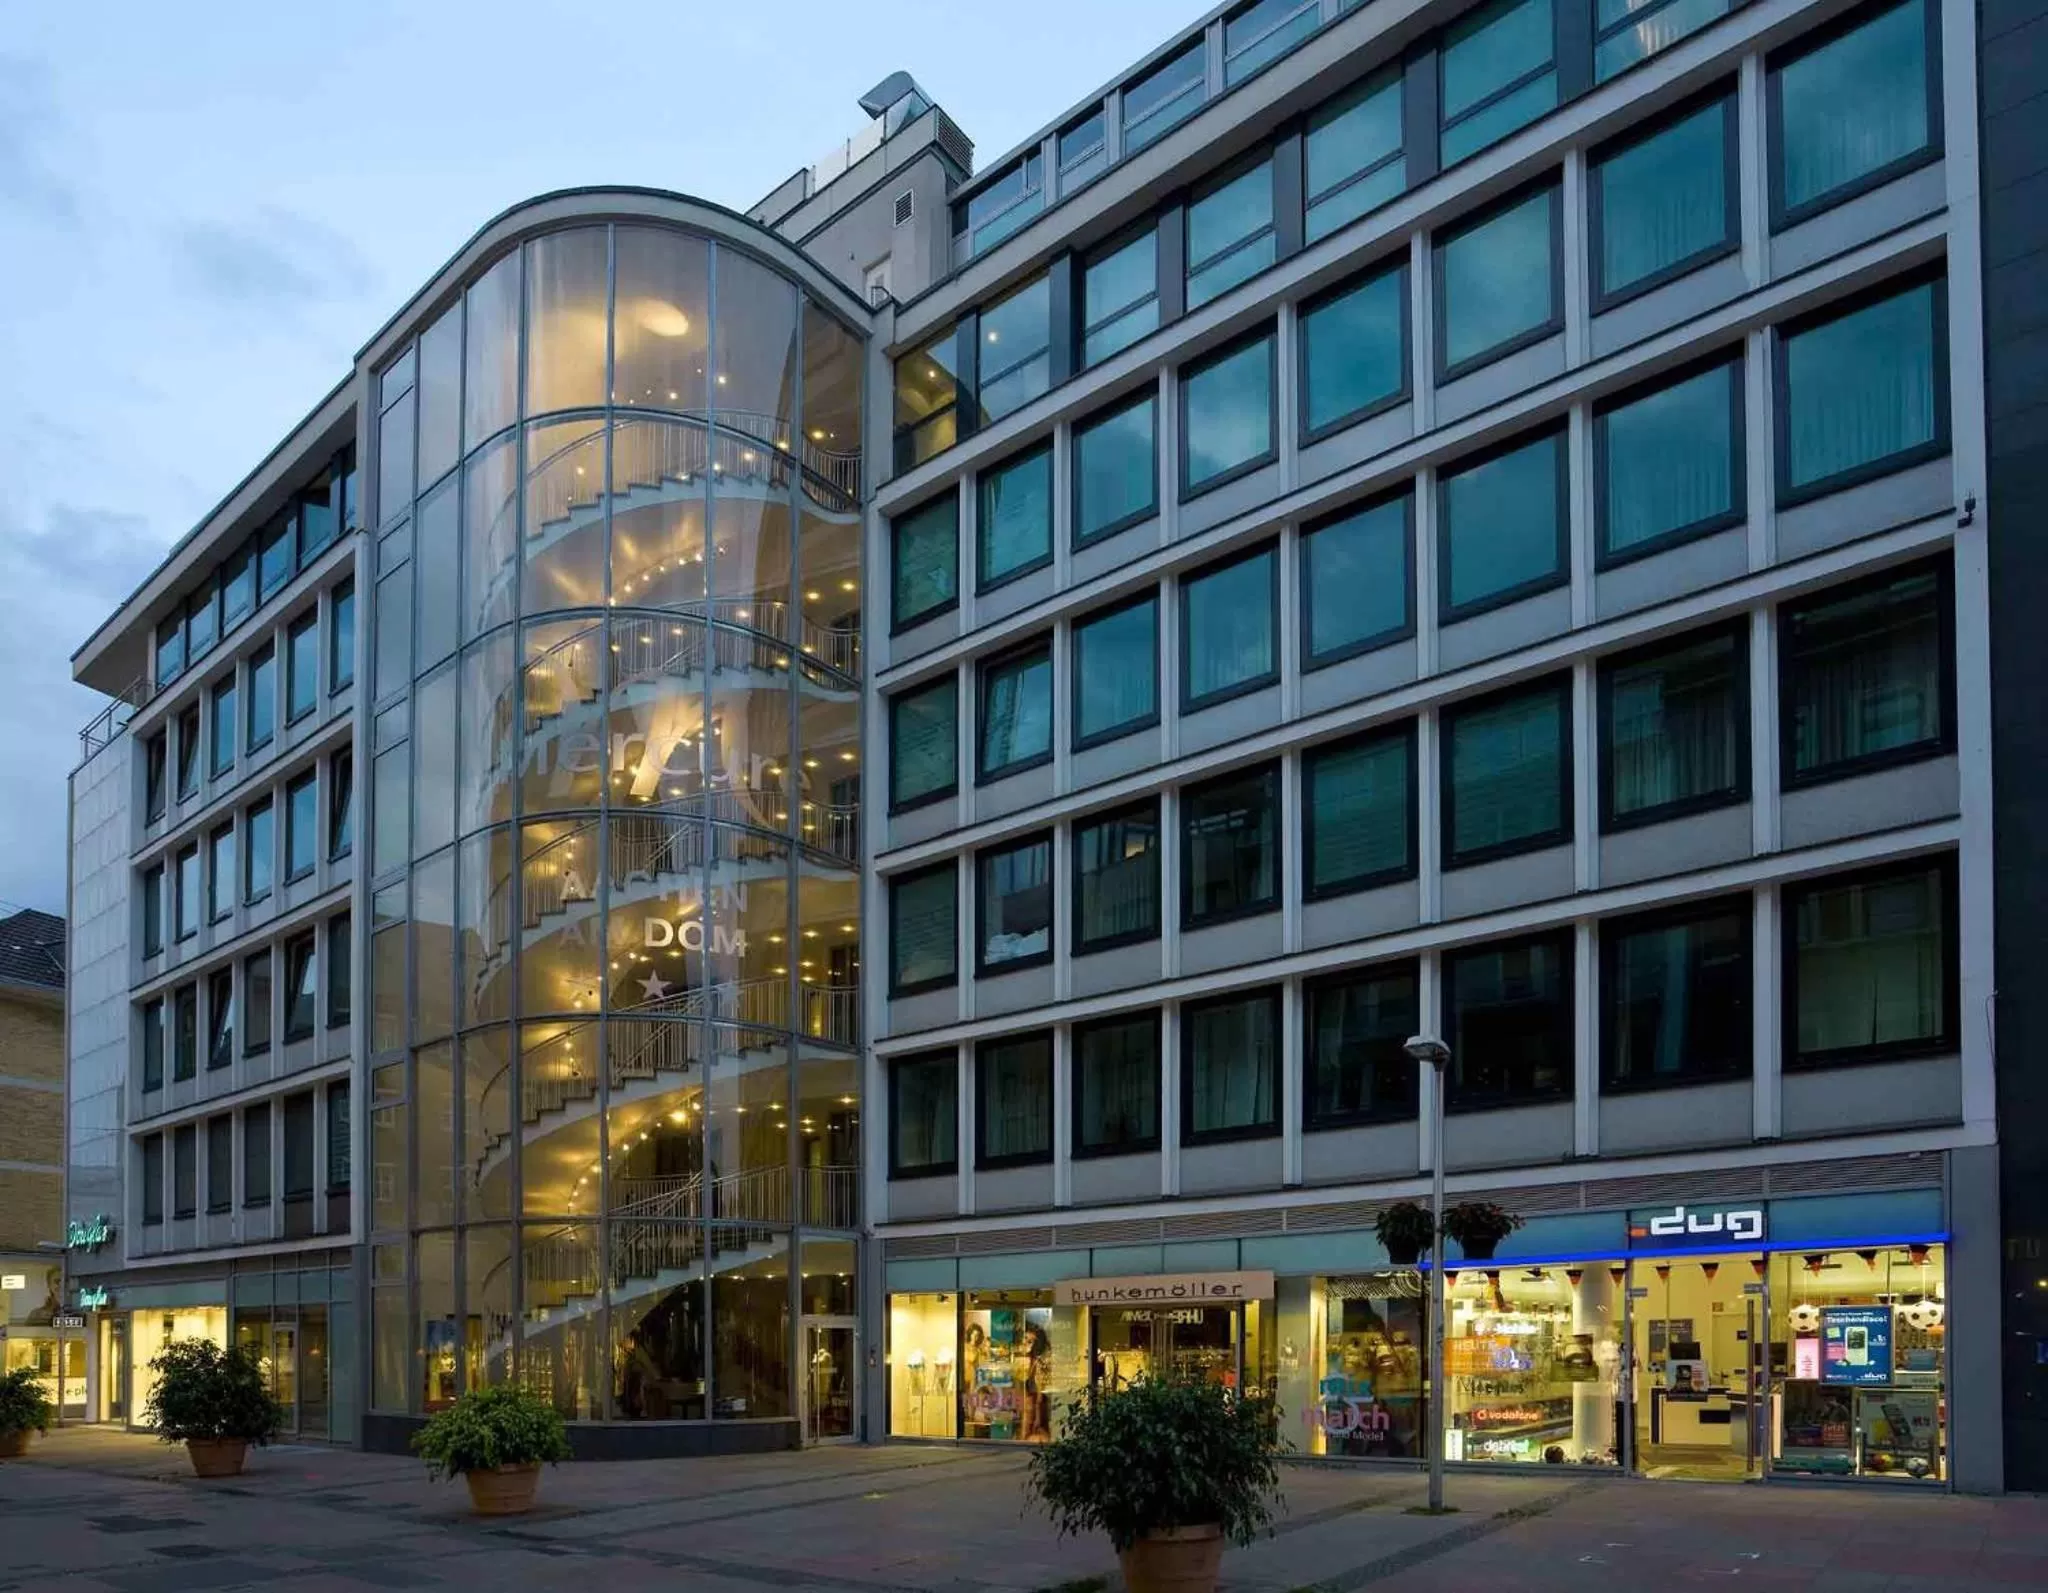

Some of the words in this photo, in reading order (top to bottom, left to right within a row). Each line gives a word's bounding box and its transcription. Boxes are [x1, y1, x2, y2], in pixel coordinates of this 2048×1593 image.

[643, 917, 747, 958] DOM
[1650, 1205, 1763, 1240] dug
[1070, 1282, 1244, 1302] hunkemöller
[1488, 1404, 1539, 1420] vodafone
